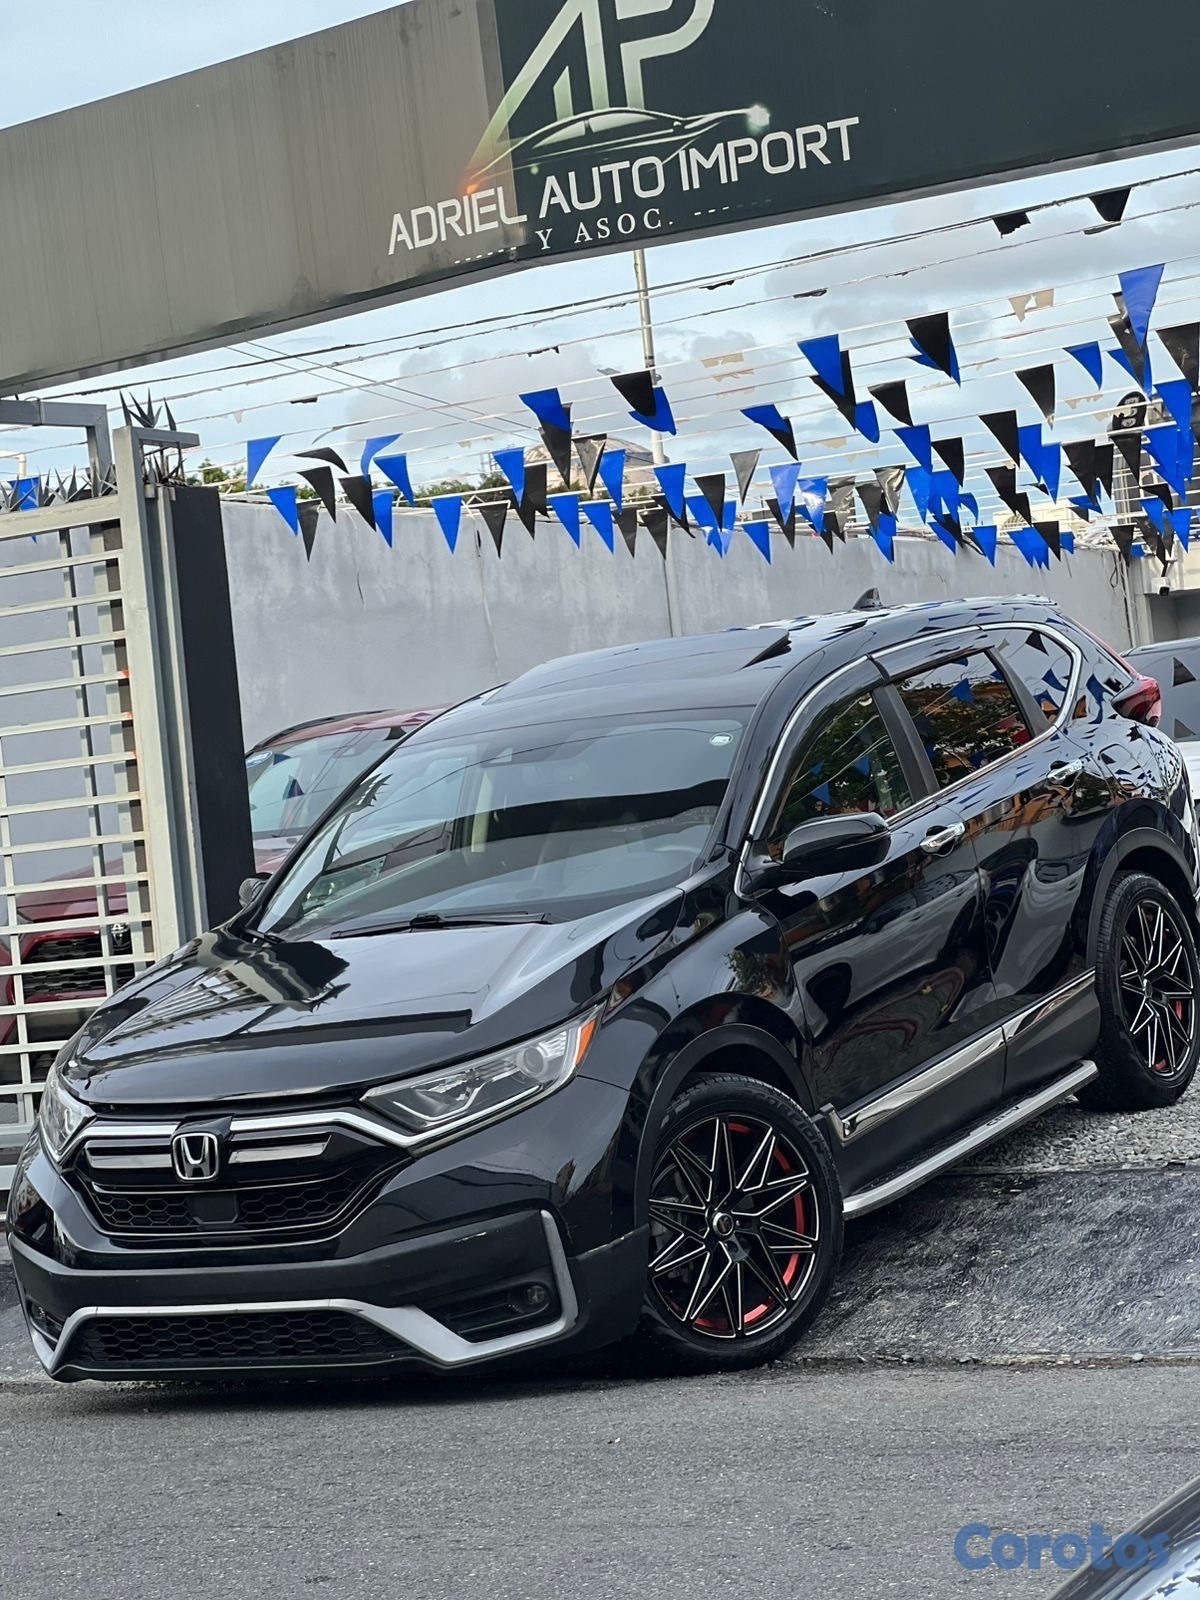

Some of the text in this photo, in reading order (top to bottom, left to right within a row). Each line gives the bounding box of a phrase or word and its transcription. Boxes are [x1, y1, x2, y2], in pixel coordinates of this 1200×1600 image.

[387, 116, 861, 257] ADRIEL AUTO IMPORT
[535, 227, 554, 250] Y
